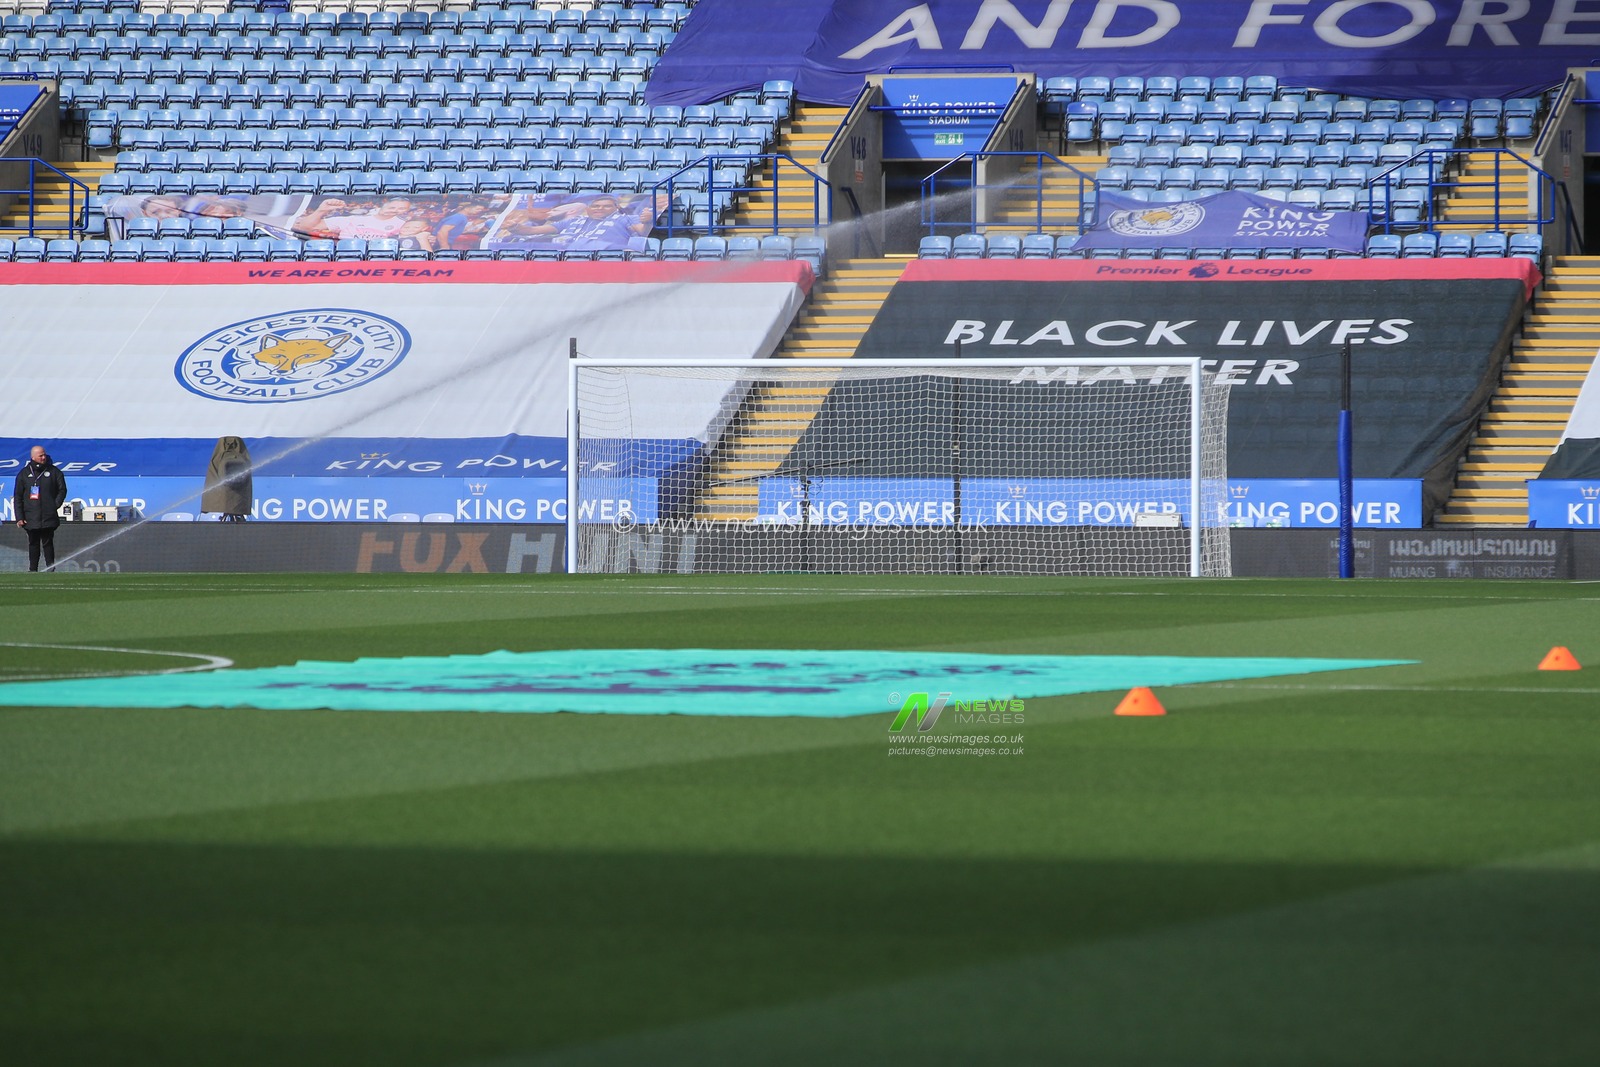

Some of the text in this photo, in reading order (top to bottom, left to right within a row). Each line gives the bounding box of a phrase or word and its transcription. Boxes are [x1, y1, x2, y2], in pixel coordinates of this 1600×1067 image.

[838, 0, 1181, 59] AND
[902, 102, 996, 115] KING POWER
[929, 116, 970, 125] STADIUM
[23, 134, 42, 156] V49
[851, 136, 867, 160] V48
[1237, 220, 1330, 231] POWER
[1242, 207, 1336, 222] KING
[248, 268, 454, 278] WE ARE ONE TEAM
[1096, 265, 1313, 277] Premier League
[203, 314, 395, 353] LEICESTER CITY
[943, 318, 1415, 346] BLACK LIVES
[192, 357, 386, 398] FOOTBALL CLUB
[0, 458, 118, 473] OER
[326, 458, 443, 472] KING
[293, 497, 388, 520] POWER
[456, 498, 632, 521] KING POWER
[777, 500, 955, 523] KING POWER
[996, 501, 1068, 523] KING
[1218, 501, 1290, 523] KING
[1568, 502, 1600, 525] KI
[1389, 566, 1437, 578] MUANG
[1484, 565, 1557, 578] INSURANCE
